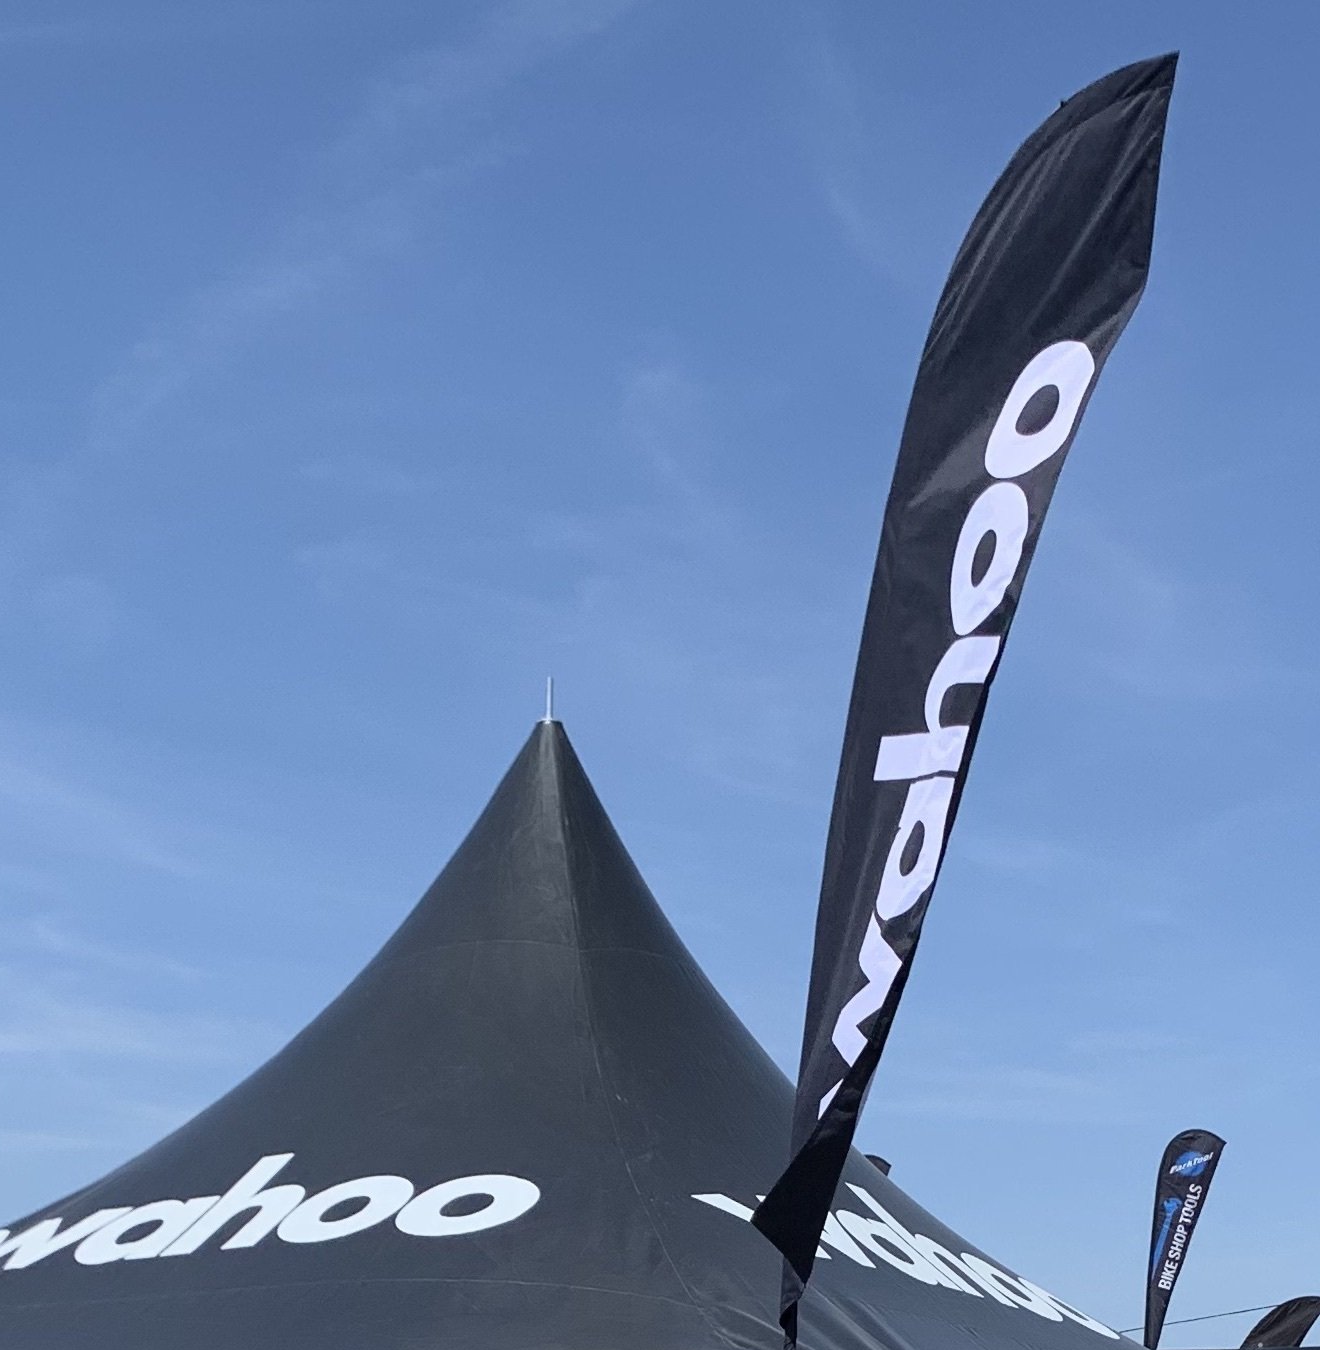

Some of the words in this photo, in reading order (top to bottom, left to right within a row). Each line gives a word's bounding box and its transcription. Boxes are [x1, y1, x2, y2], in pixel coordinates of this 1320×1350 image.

[817, 339, 1095, 1123] wahoo
[1157, 1256, 1178, 1291] BIKE
[1169, 1223, 1188, 1260] SHOP
[1179, 1183, 1203, 1224] TOOLS
